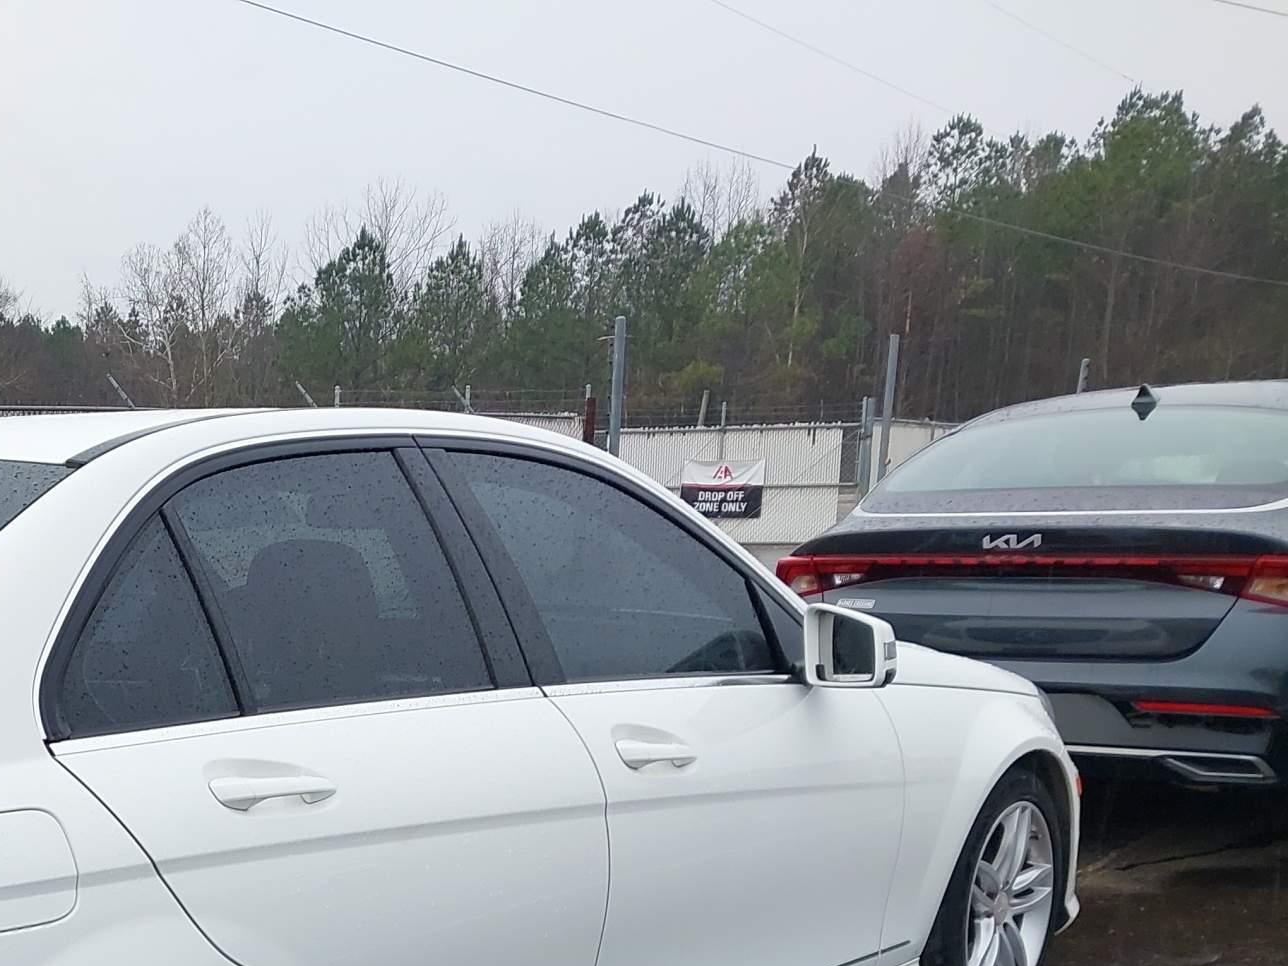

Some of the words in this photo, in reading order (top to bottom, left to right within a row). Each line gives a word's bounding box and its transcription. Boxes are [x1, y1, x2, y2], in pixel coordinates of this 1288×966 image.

[698, 491, 725, 501] DROP
[727, 491, 745, 501] OFF
[693, 502, 720, 512] ZONE
[721, 502, 747, 512] ONLY
[983, 534, 1042, 549] KIA
